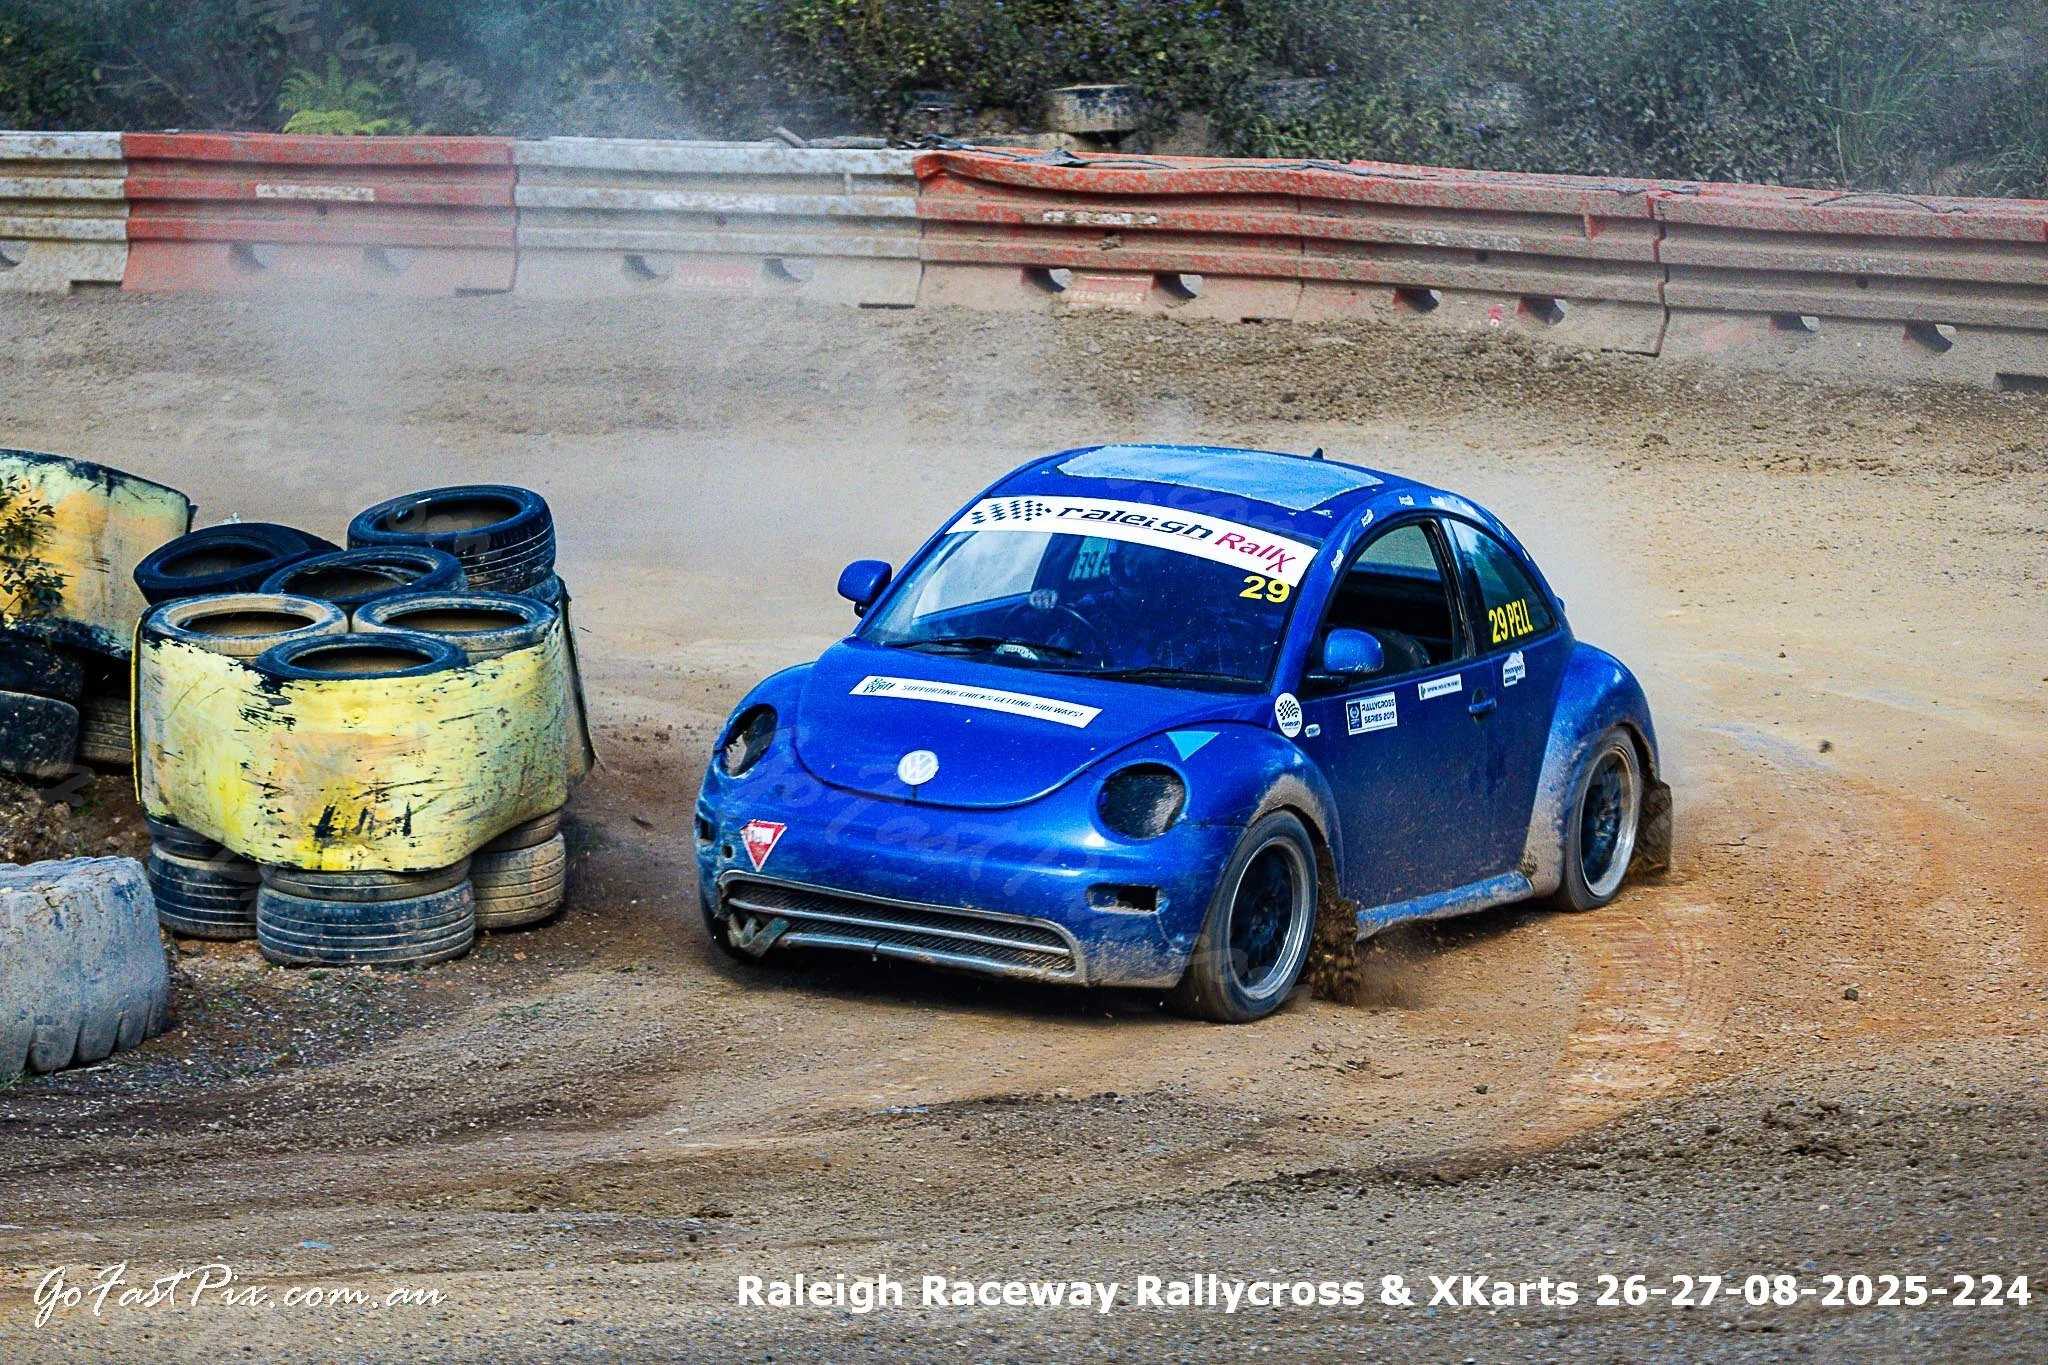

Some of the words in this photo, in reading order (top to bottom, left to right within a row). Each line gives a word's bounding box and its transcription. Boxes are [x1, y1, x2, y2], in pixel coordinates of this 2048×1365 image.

[1055, 504, 1214, 541] raleigh
[1239, 575, 1291, 603] 29
[1488, 606, 1508, 644] 29
[1506, 598, 1534, 638] PELL
[901, 684, 958, 696] SUPPORTING
[958, 691, 994, 702] CHICKS
[994, 696, 1033, 707] GETTING
[1034, 703, 1084, 718] SIDEWAYS!
[1361, 698, 1395, 712] RALLYCROSS
[1364, 713, 1383, 724] SERIES
